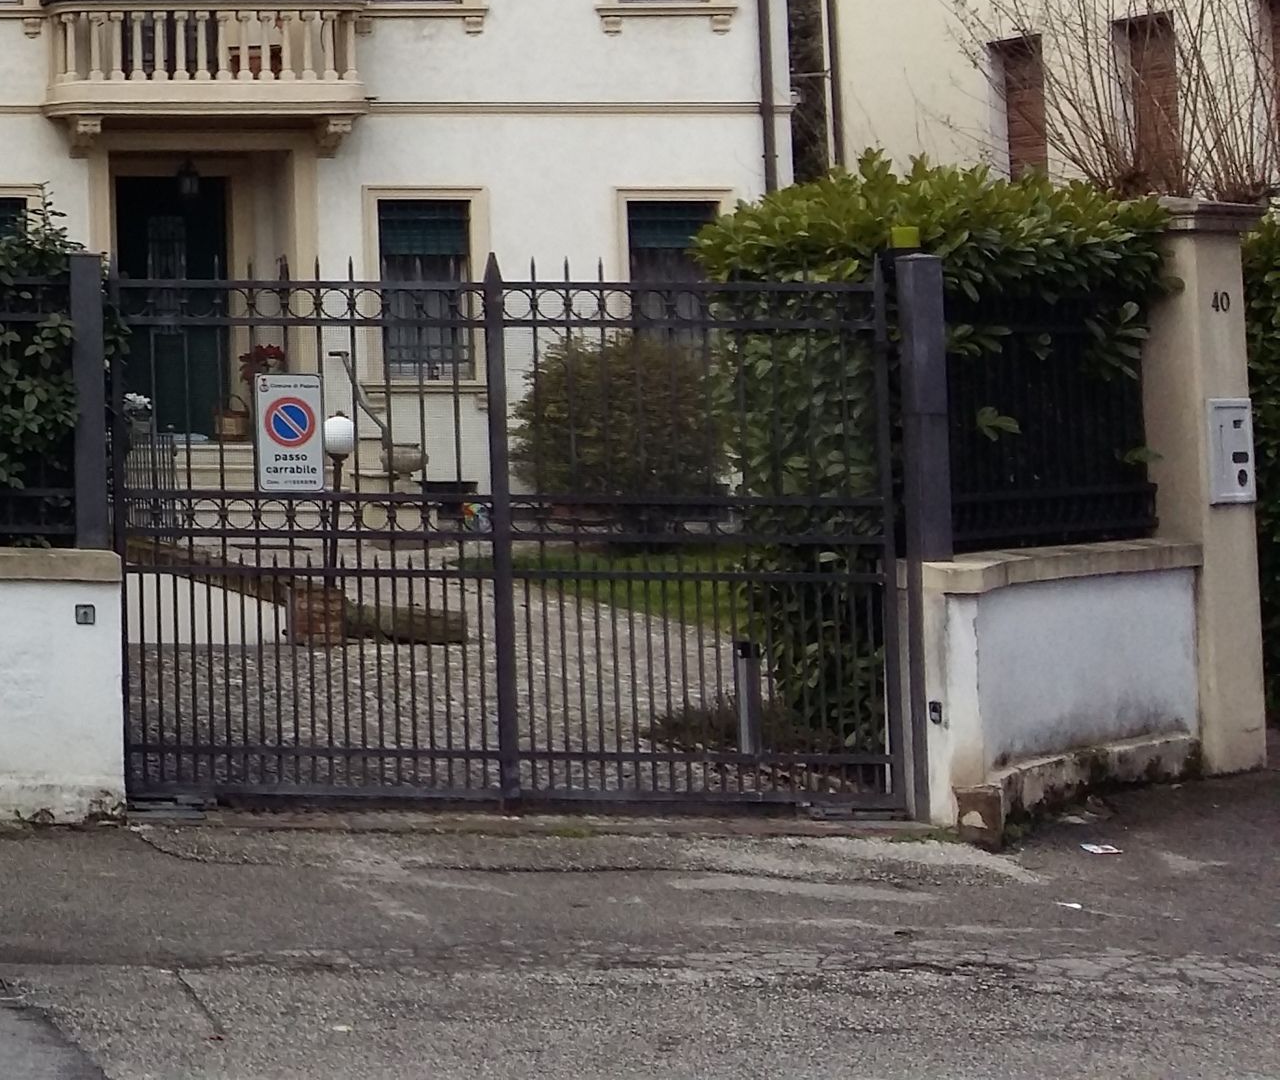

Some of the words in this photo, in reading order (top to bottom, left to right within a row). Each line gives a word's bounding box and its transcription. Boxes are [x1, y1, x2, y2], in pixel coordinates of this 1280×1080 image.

[1211, 289, 1231, 313] 40
[274, 454, 308, 462] passo
[266, 465, 317, 474] carrabile
